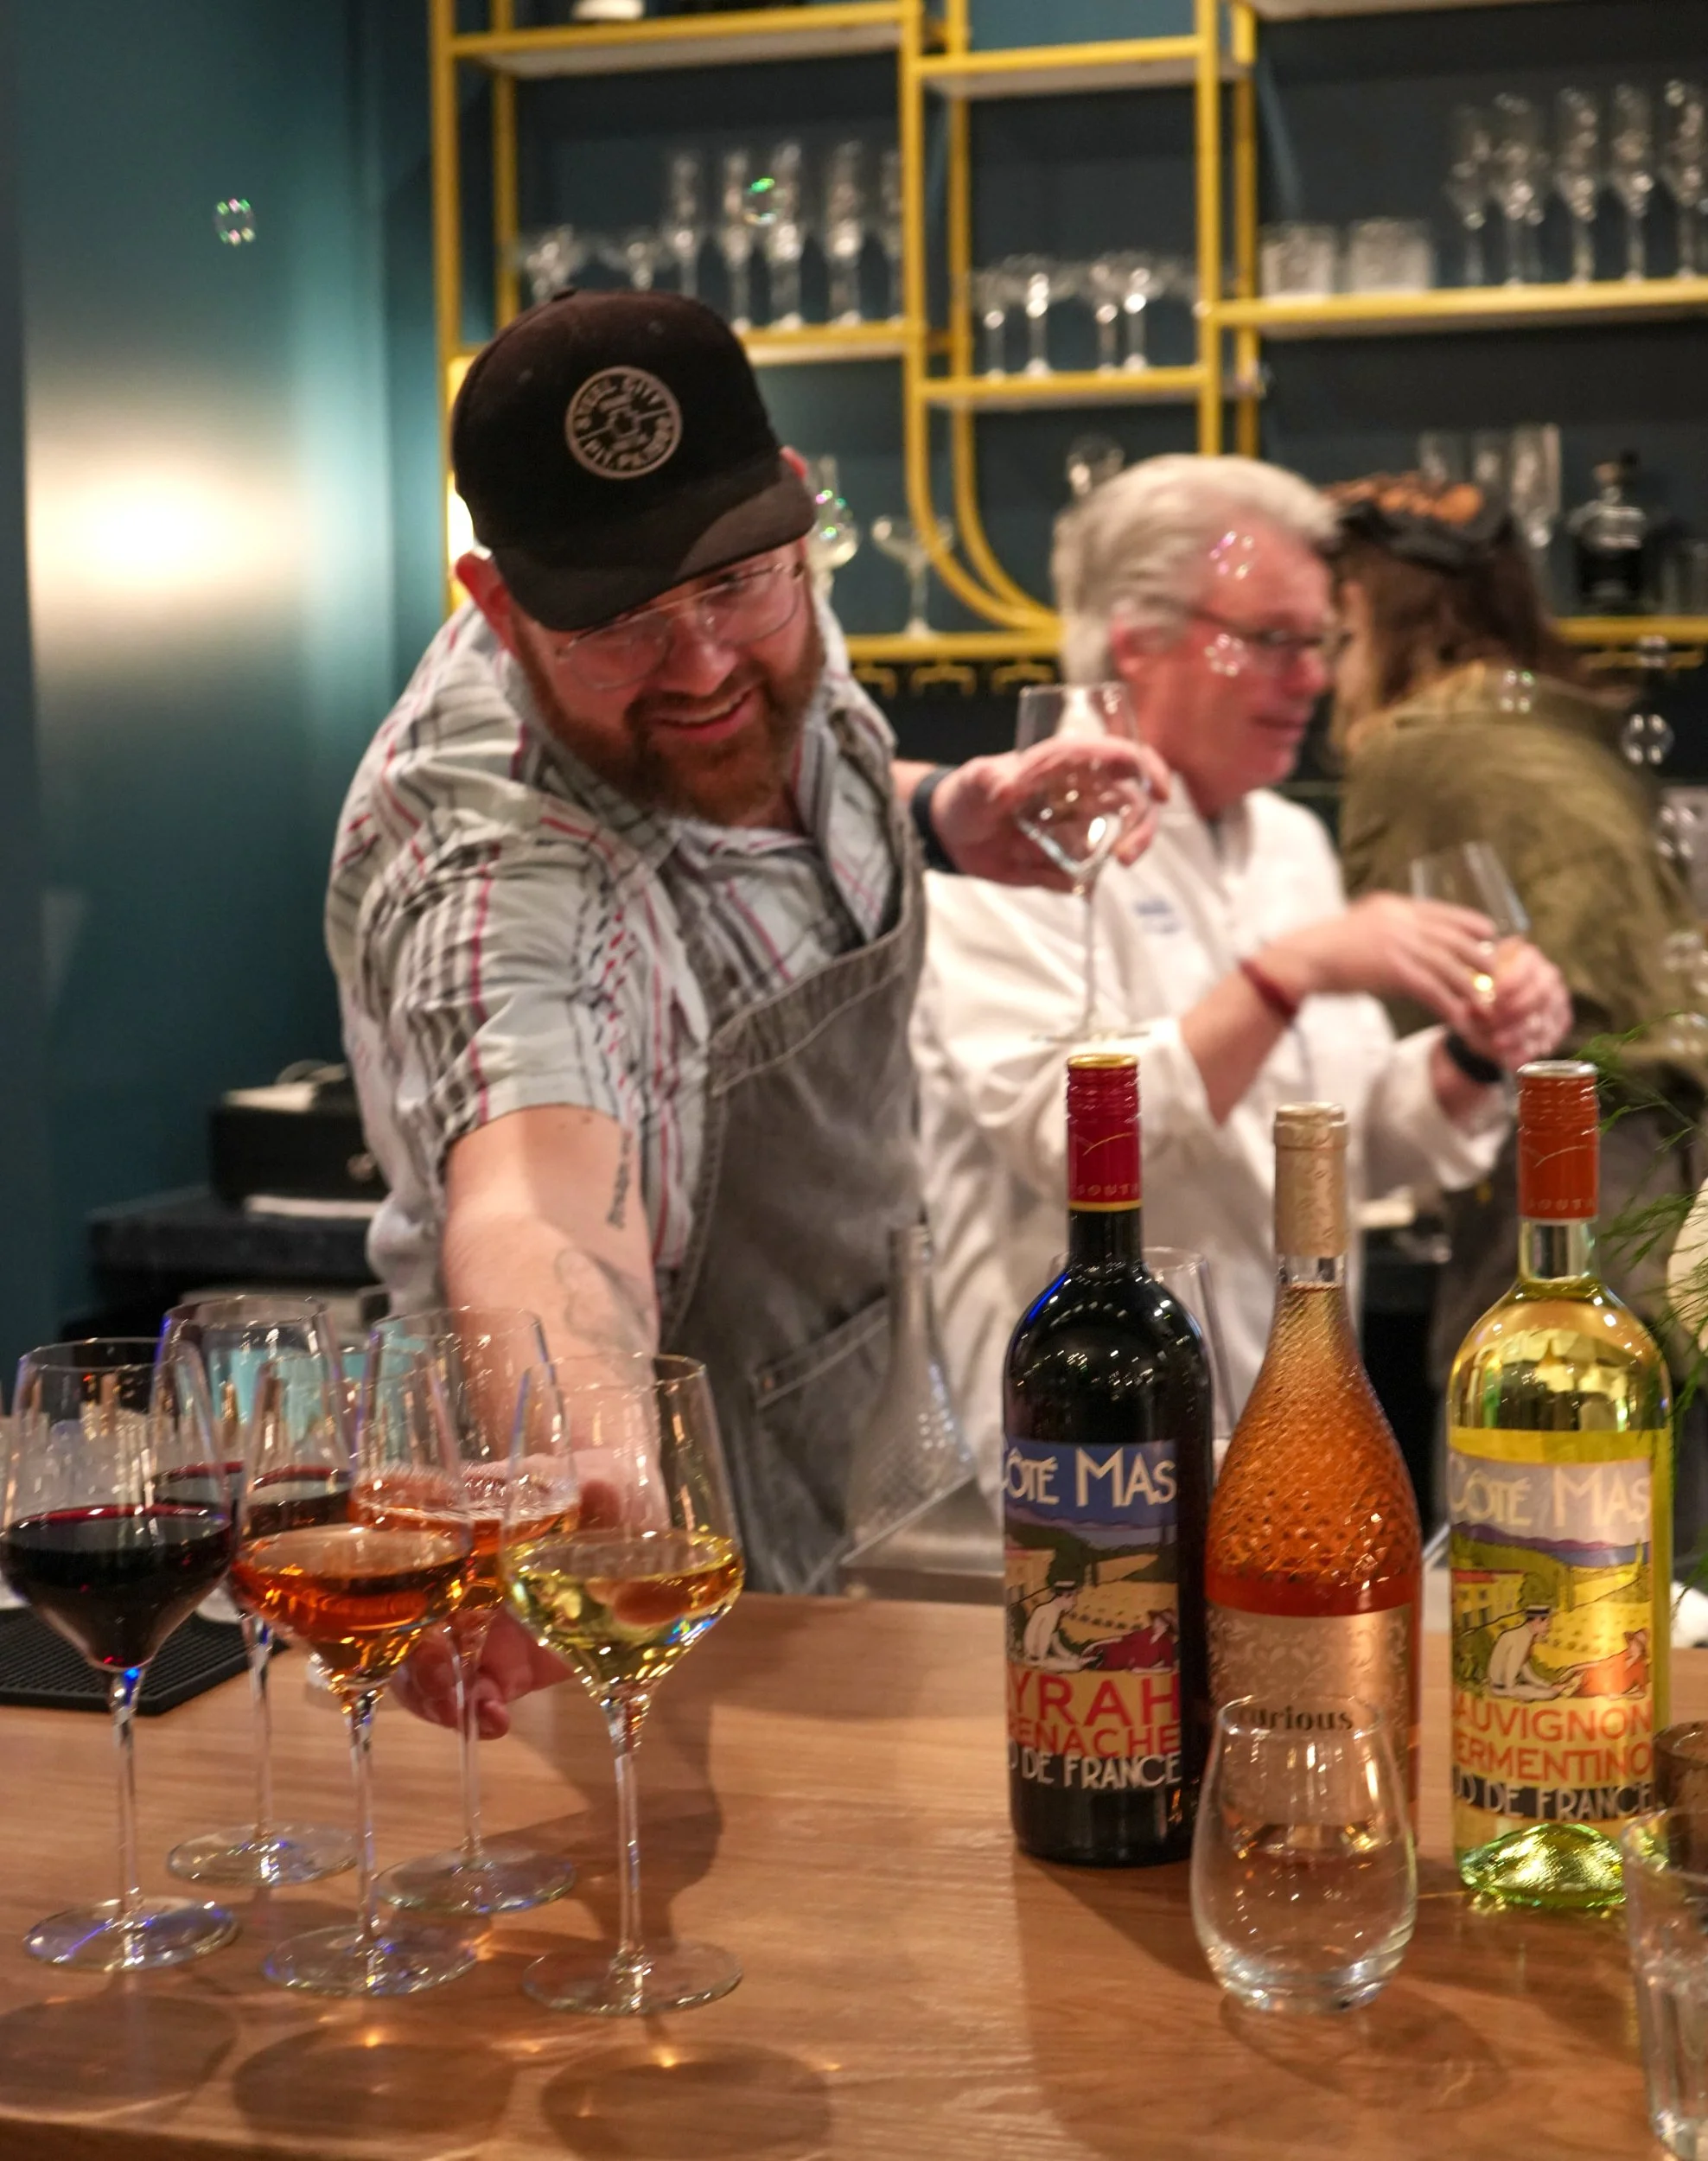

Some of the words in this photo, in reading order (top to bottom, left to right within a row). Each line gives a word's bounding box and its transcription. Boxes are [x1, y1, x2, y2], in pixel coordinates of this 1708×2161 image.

[1000, 1446, 1060, 1505] ÔTÉ
[1076, 1446, 1177, 1508] MAS
[1552, 1466, 1651, 1527] MAS
[1008, 1667, 1181, 1726] YRAH
[1451, 1695, 1653, 1742] AUVIGNON
[1009, 1714, 1181, 1758] ENACHE
[1452, 1729, 1653, 1782] ERMENTINO
[1022, 1746, 1055, 1785] DE
[1063, 1751, 1182, 1789] FRANCE
[1484, 1782, 1524, 1817] DE
[1536, 1782, 1653, 1820] FRANCE
